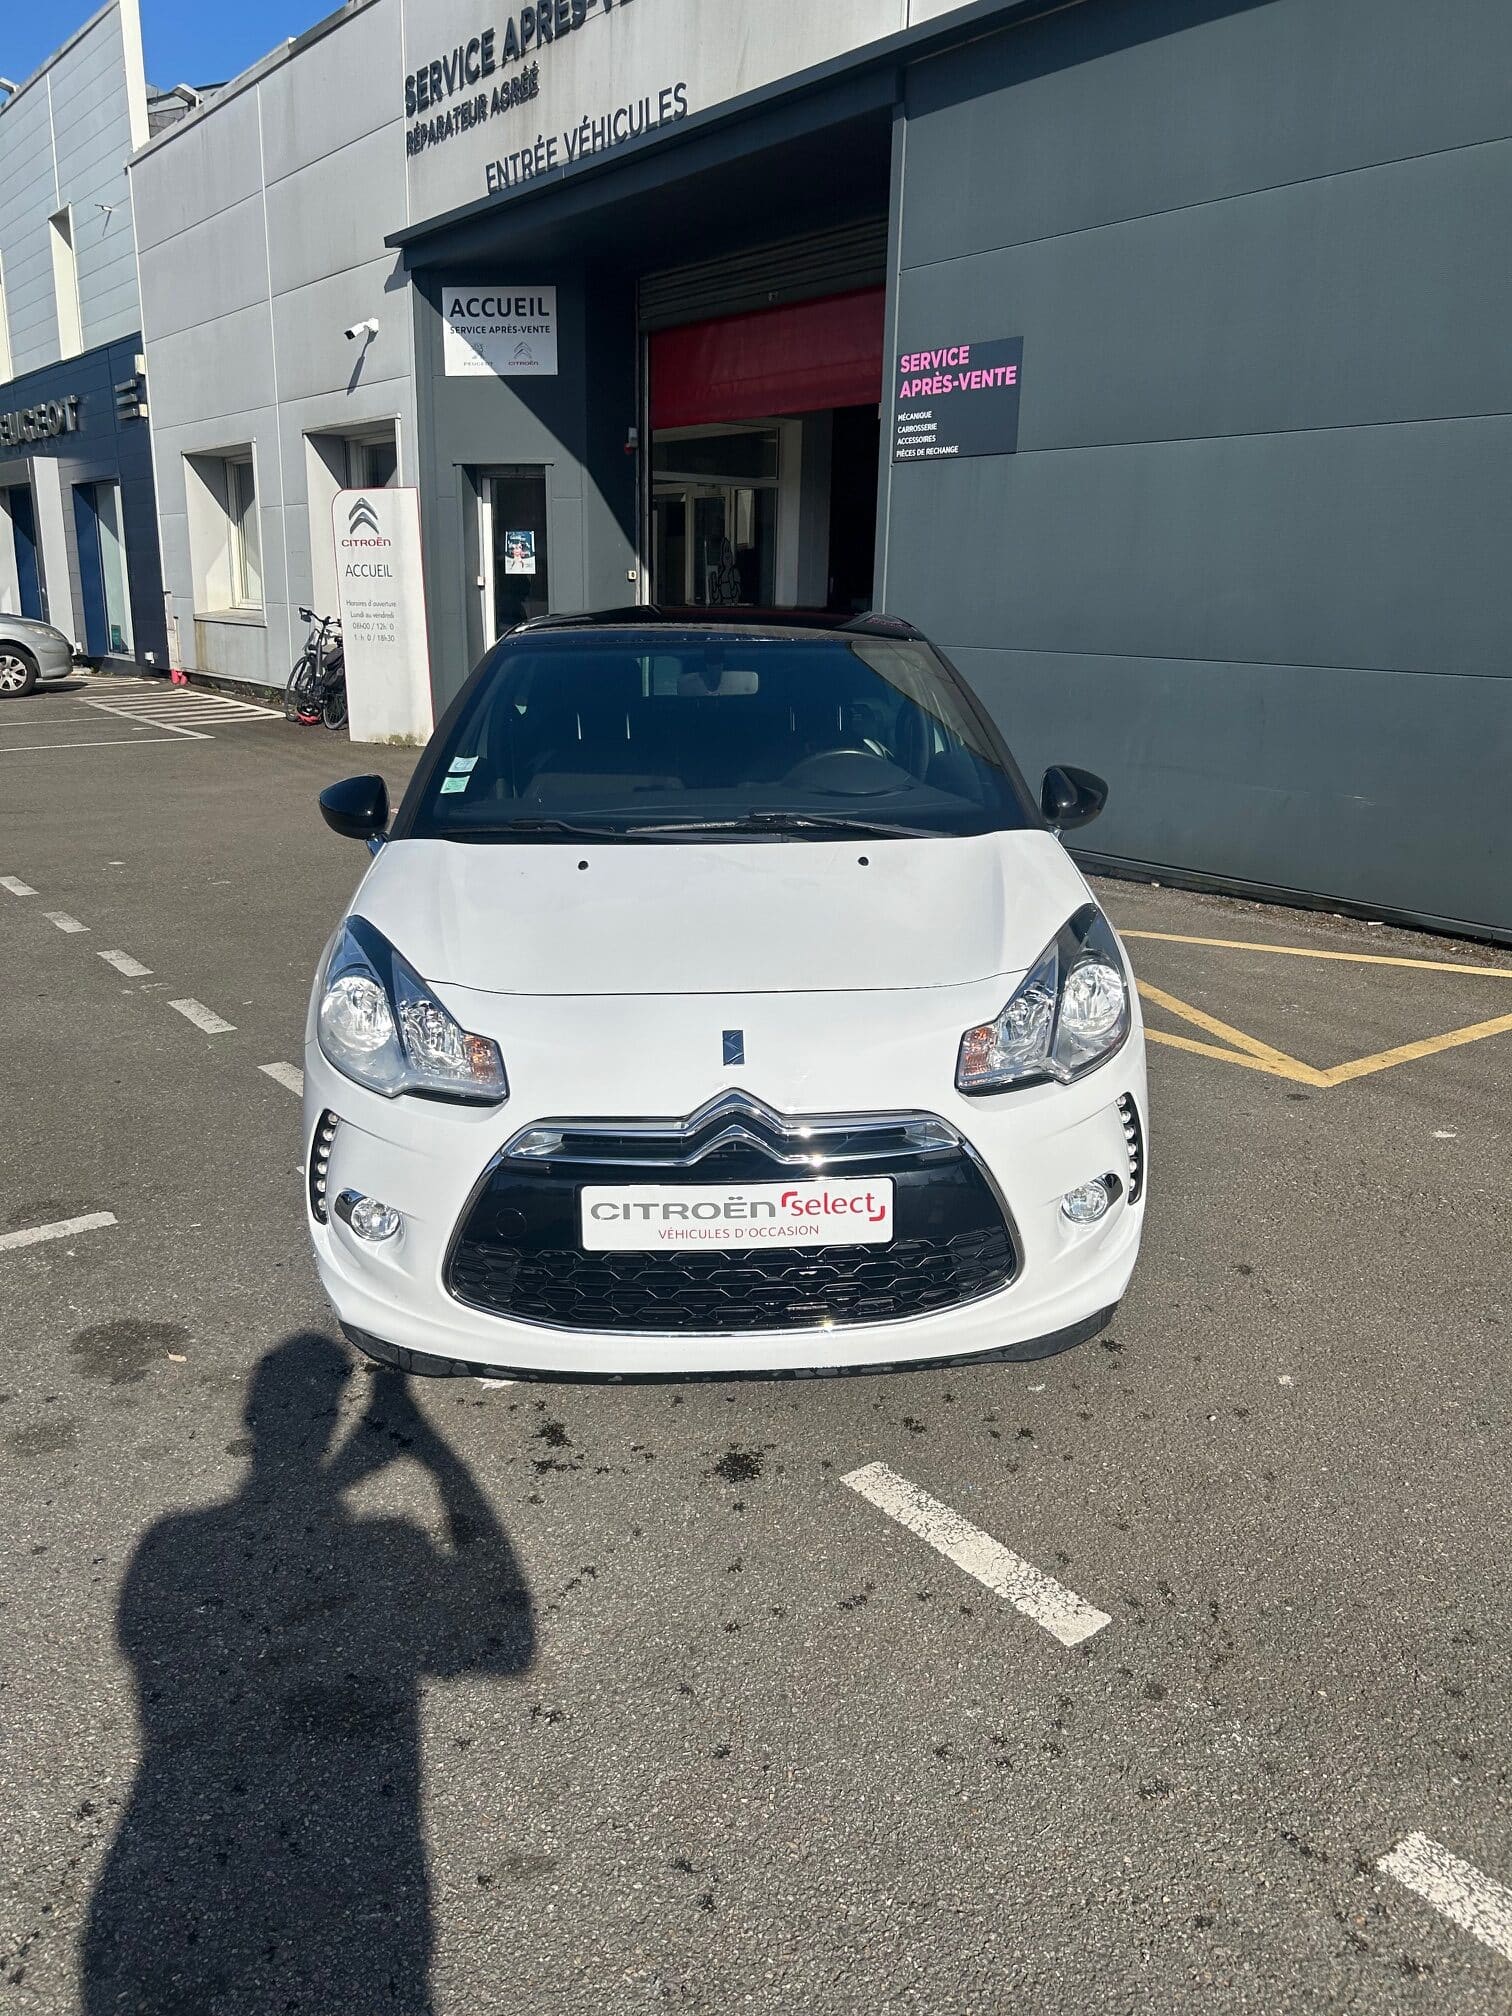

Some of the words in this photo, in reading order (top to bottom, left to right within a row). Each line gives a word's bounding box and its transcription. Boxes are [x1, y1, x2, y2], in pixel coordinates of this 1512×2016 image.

[405, 28, 496, 118] SERVICE
[406, 93, 488, 160] RÉPARATEUR
[490, 61, 540, 119] AGRÉÉ
[486, 134, 559, 195] ENTRÉE
[563, 82, 689, 161] VÉHICULES
[449, 297, 550, 318] ACCUEIL
[450, 326, 487, 334] SERVICE
[489, 323, 551, 334] APRÈS-VENTE
[900, 345, 970, 374] SERVICE
[899, 365, 1017, 399] APRÈS-VENTE
[897, 411, 933, 421] MÉCANIQUE
[897, 423, 938, 434] CARROSSERIE
[896, 434, 937, 445] ACCESSOIRES
[896, 448, 916, 458] PIÈCES
[916, 448, 926, 456] DE
[926, 445, 960, 455] RECHANGE
[345, 564, 393, 578] ACCUEIL
[790, 1192, 875, 1217] select
[658, 1227, 730, 1240] VÉHICULES
[734, 1224, 819, 1238] D'OCCASION
